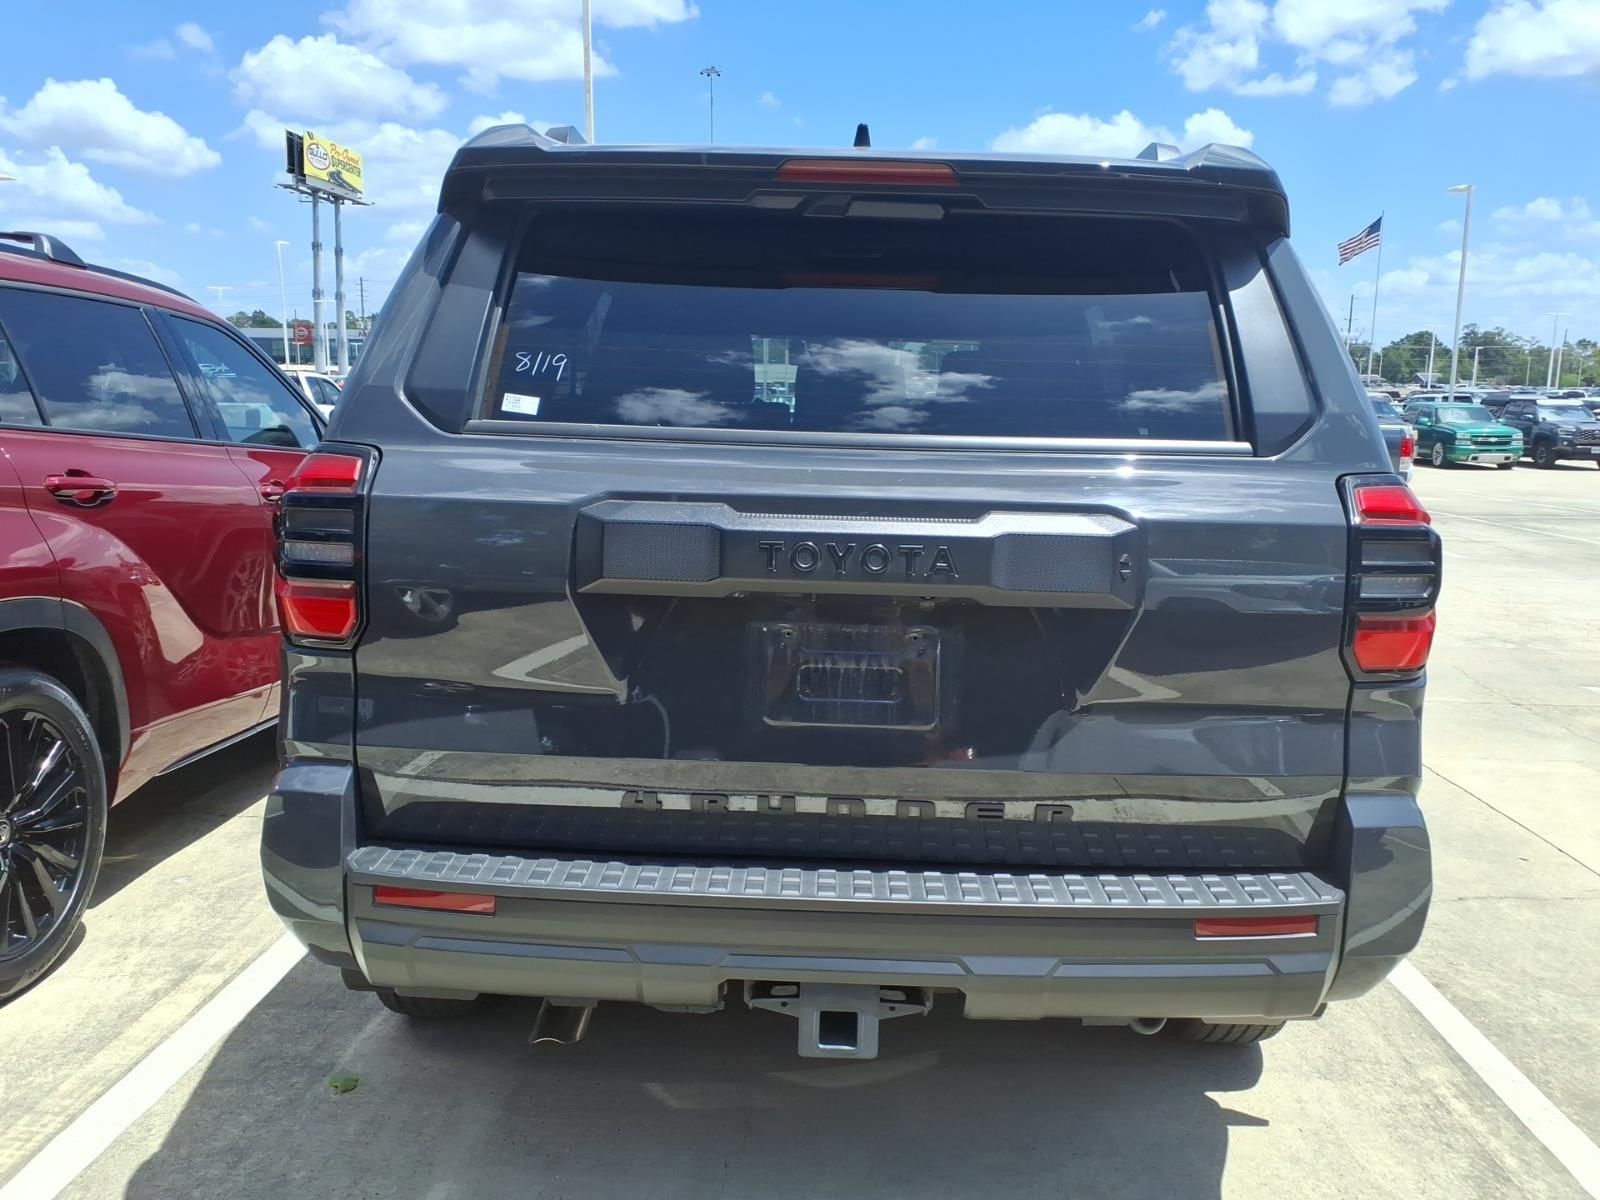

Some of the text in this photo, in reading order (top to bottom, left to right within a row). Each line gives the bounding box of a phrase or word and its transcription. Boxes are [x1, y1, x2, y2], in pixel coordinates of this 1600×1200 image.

[331, 155, 361, 177] SUPERCENTER
[515, 351, 568, 382] 8/19
[758, 539, 960, 578] TOYOTA
[620, 790, 1074, 823] 4RUNNER
